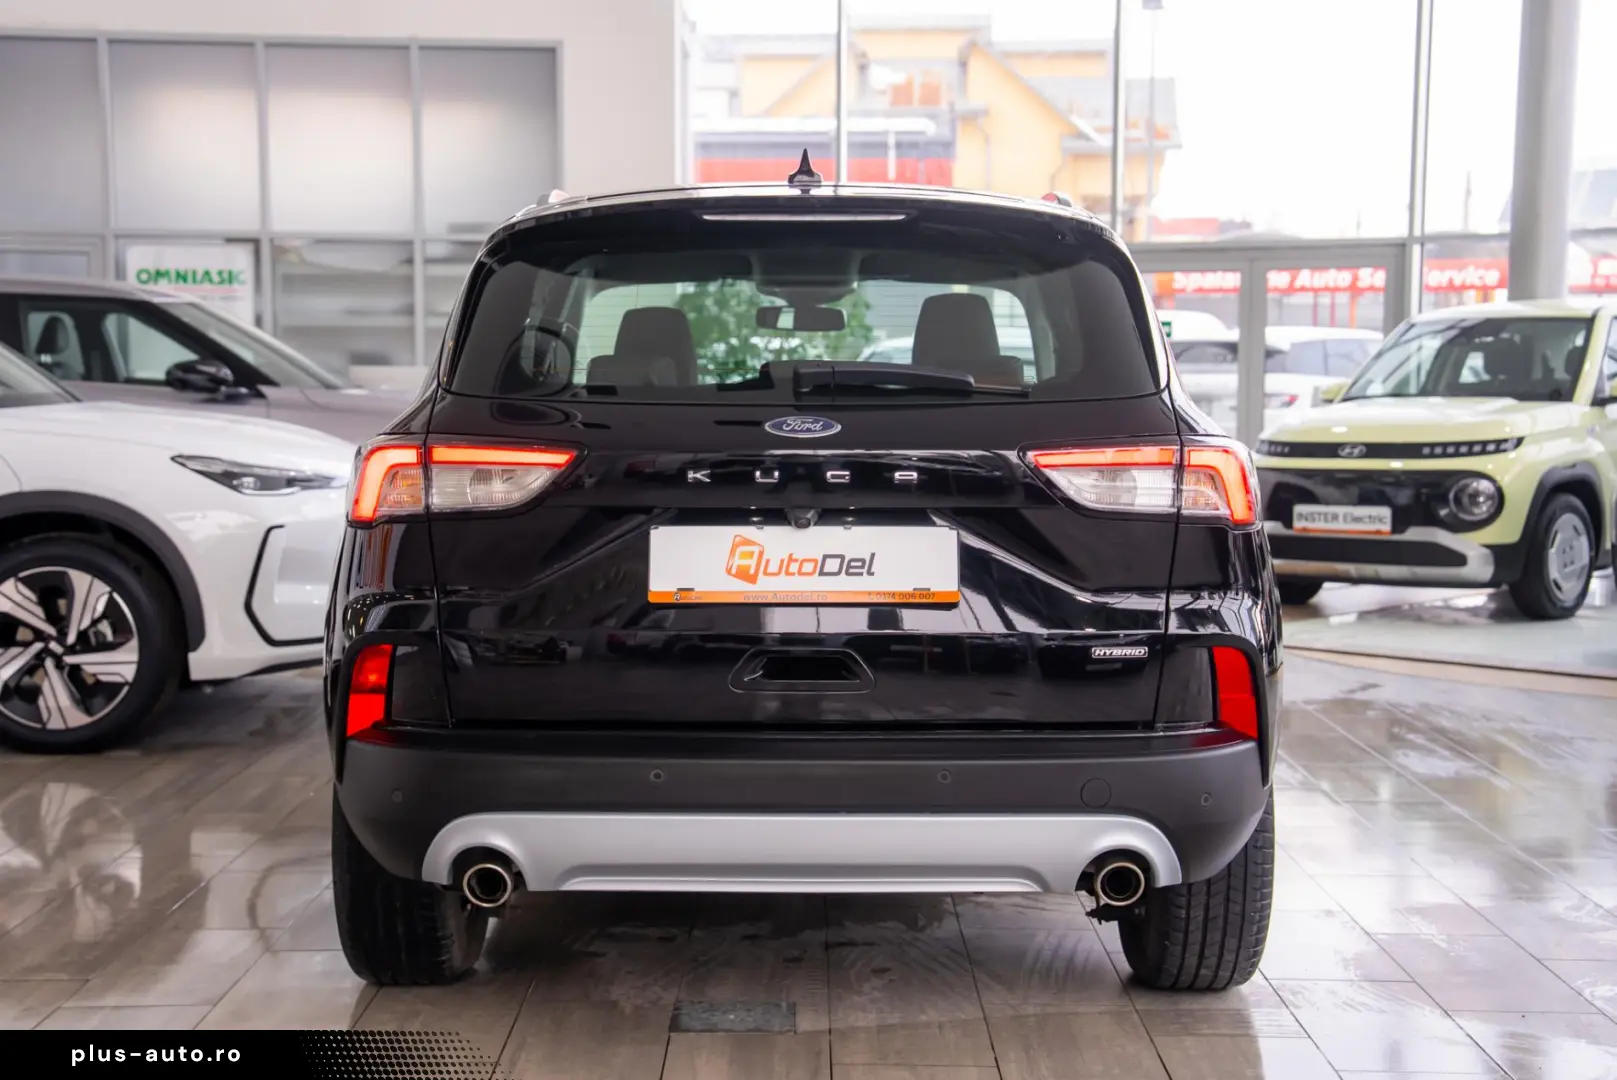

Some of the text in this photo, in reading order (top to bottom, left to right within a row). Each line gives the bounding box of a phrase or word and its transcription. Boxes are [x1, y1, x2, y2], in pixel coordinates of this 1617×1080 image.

[1295, 268, 1352, 288] Auto
[782, 419, 823, 431] Ford
[1296, 511, 1388, 525] INSTER Electric
[726, 534, 876, 585] AutoDel
[1094, 648, 1146, 656] HYBRID
